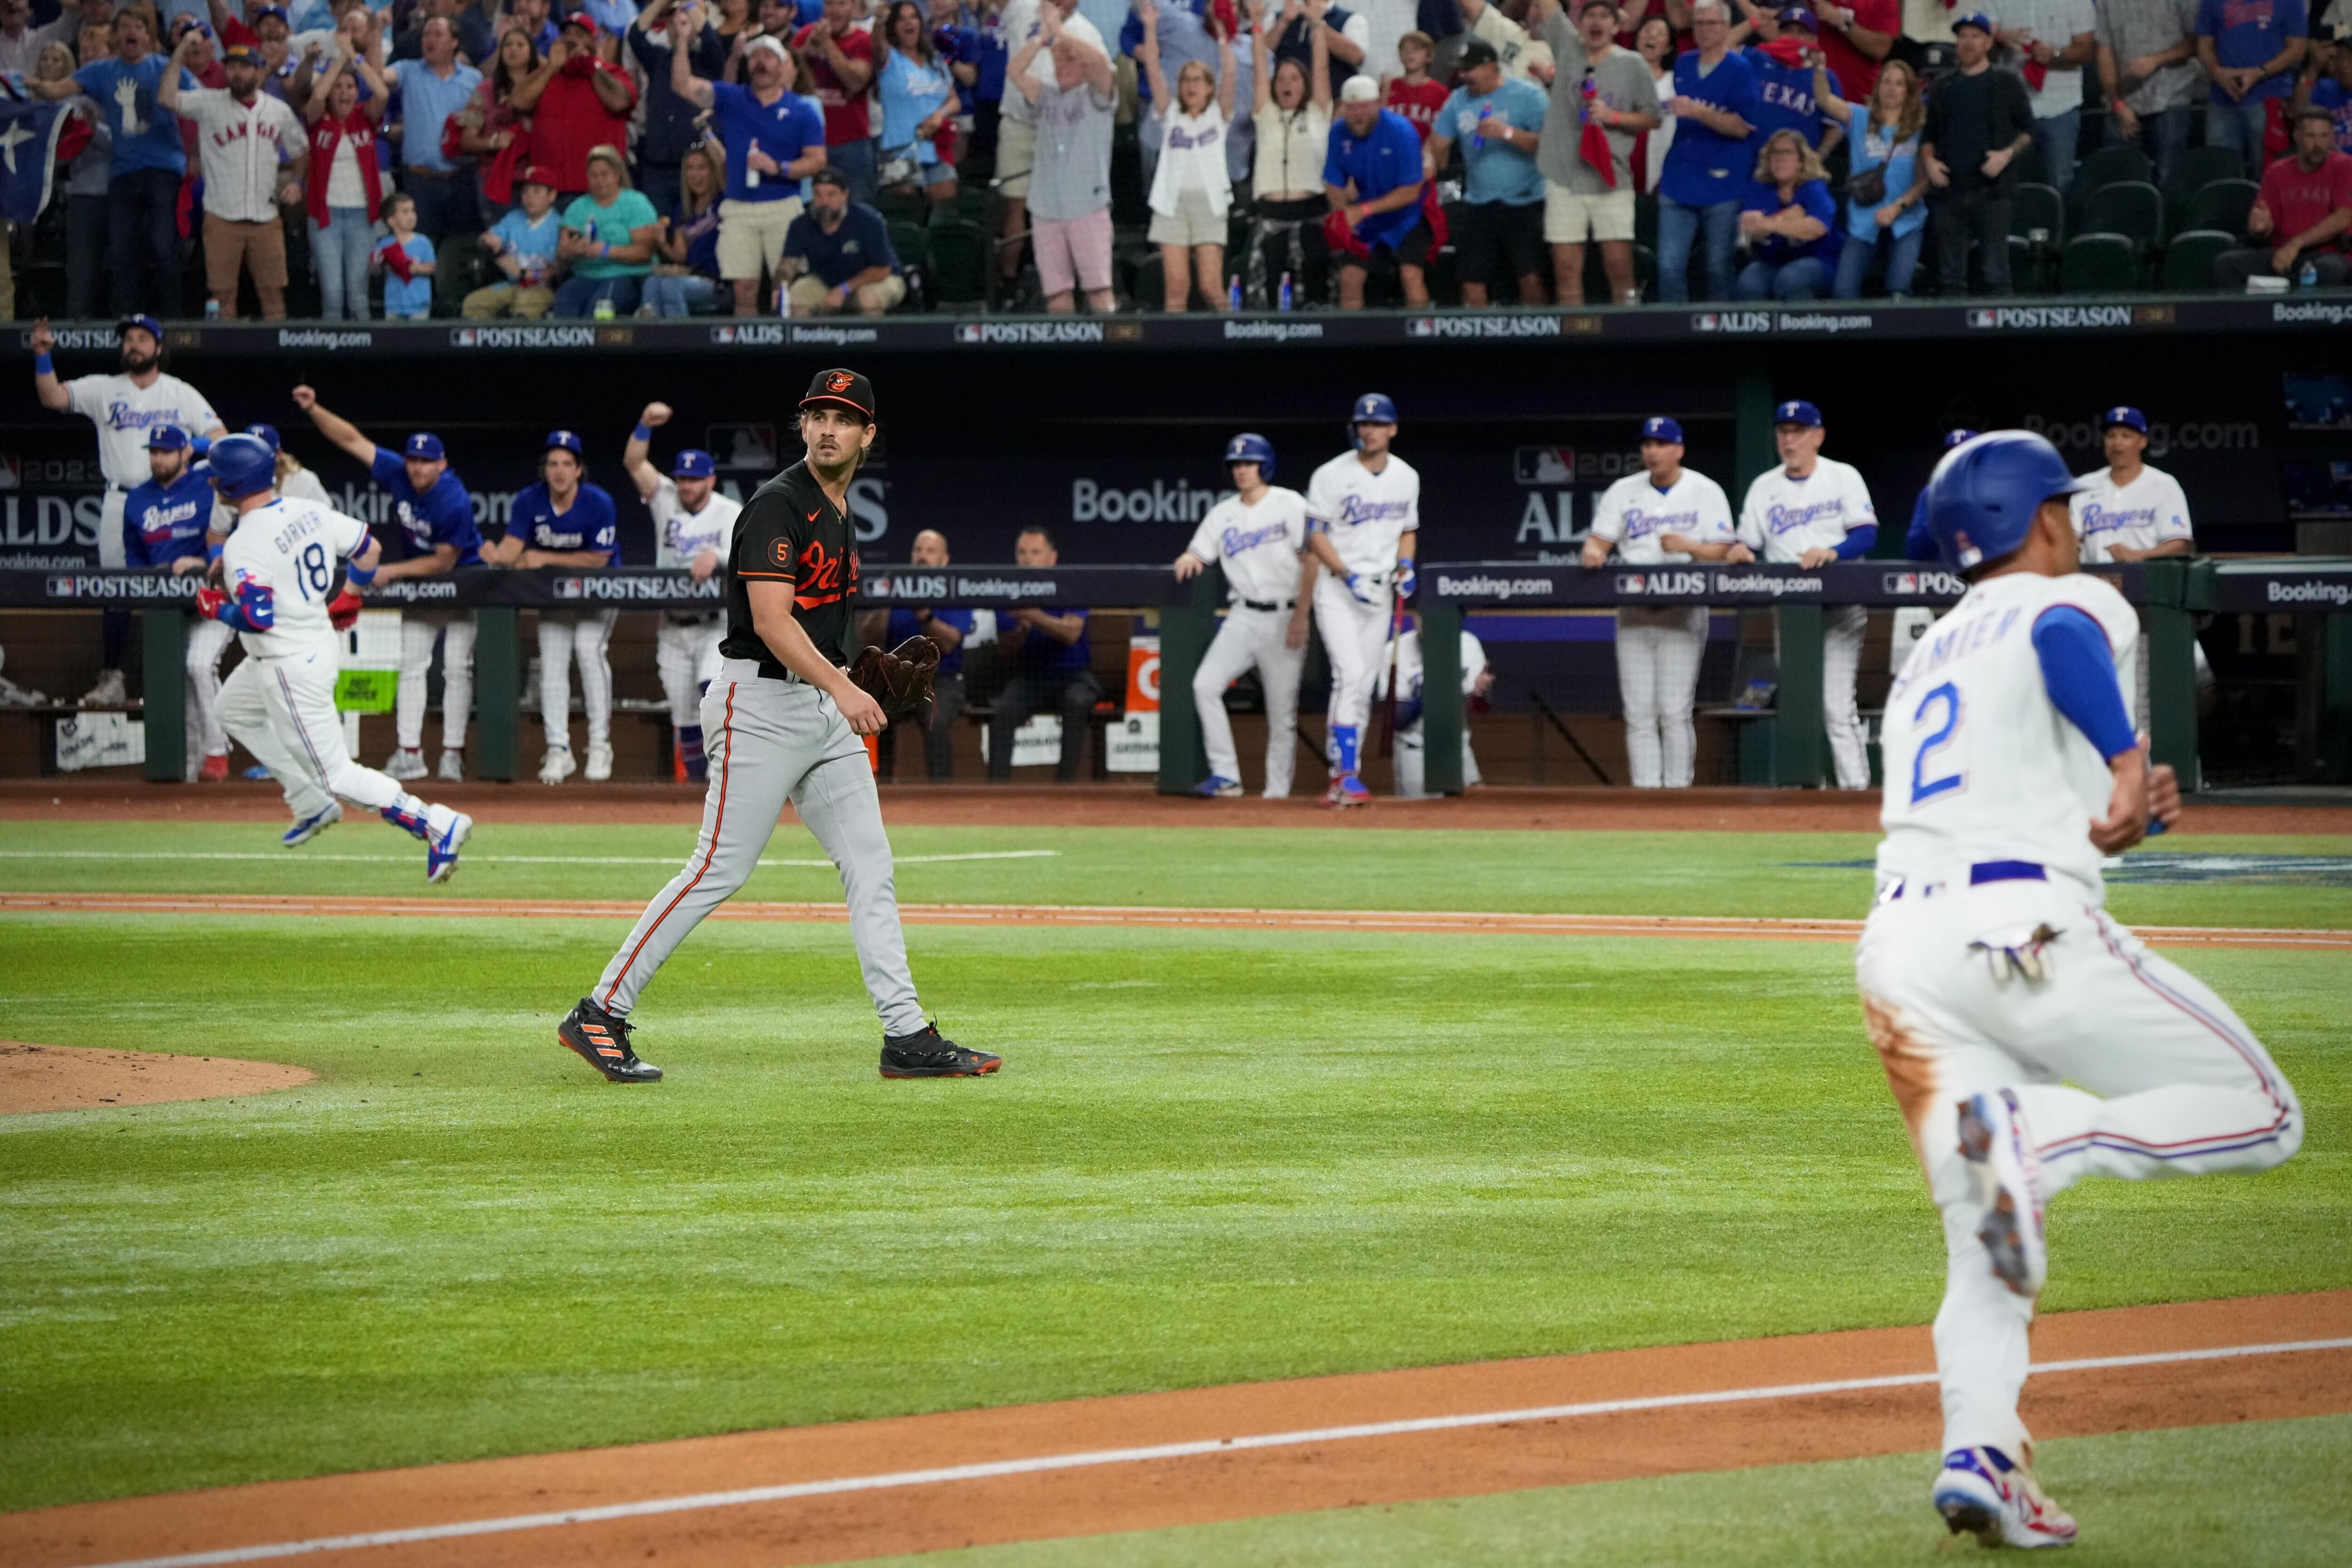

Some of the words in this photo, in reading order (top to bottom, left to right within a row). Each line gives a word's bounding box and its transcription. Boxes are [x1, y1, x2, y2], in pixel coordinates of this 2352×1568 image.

[1760, 80, 1815, 117] EXAS
[1433, 316, 1561, 337] POSTSEASON
[1717, 312, 1771, 333] ALDS
[1779, 312, 1872, 333] Booking.com
[1995, 307, 2131, 328] POSTSEASON
[278, 328, 372, 350] Booking.com
[476, 327, 595, 347] POSTSEASON
[735, 325, 783, 344] ALDS
[792, 326, 877, 345] Booking.com
[981, 322, 1103, 342] POSTSEASON
[1224, 320, 1323, 342] Booking.com
[1364, 399, 1377, 414] T
[1785, 401, 1800, 417] T
[2114, 406, 2129, 422] T
[1650, 417, 1663, 431] T
[414, 433, 428, 449] T
[557, 430, 571, 445] T
[683, 453, 696, 469] T
[0, 495, 103, 546] LDS
[1767, 499, 1843, 535] Rangers
[2082, 503, 2156, 535] Rangers
[275, 511, 321, 554] GARVER
[596, 525, 616, 546] 47
[777, 544, 789, 561] 5
[294, 542, 328, 601] 18
[583, 576, 721, 599] POSTSEASON
[891, 577, 947, 598] ALDS
[958, 578, 1057, 600] Booking.com
[1438, 574, 1553, 600] Booking.com
[1644, 573, 1706, 595] ALDS
[1716, 575, 1822, 597] Booking.com
[2267, 580, 2352, 605] Booking.
[1909, 680, 1968, 813] 2
